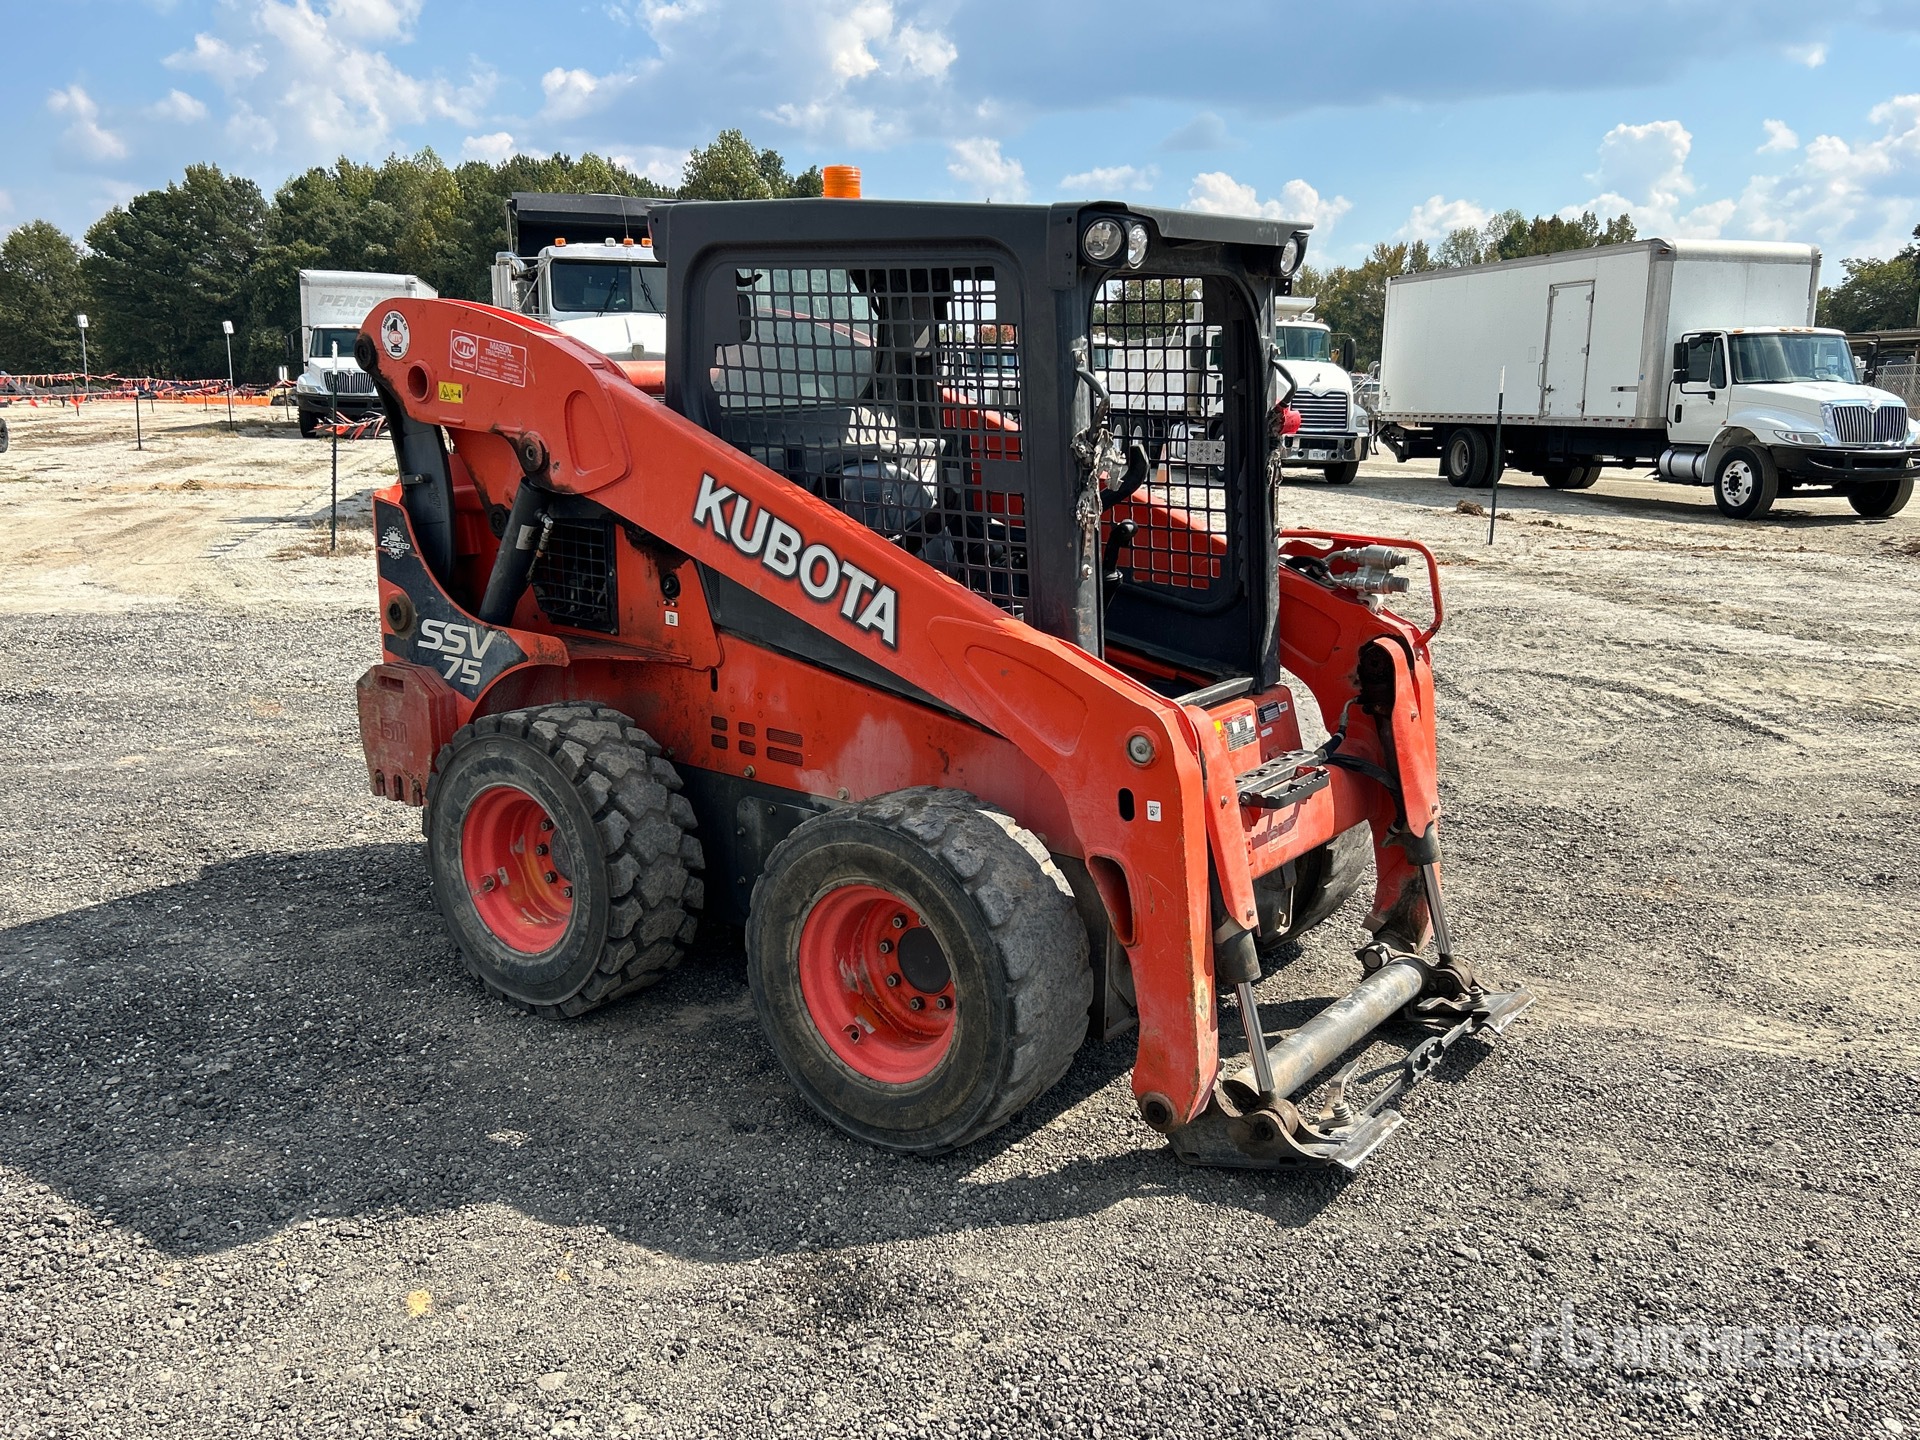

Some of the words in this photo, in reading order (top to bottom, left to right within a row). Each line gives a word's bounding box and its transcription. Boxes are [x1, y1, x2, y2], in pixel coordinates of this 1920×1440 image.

[489, 342, 512, 354] MASON
[692, 472, 897, 648] KUBOTA
[417, 618, 496, 660] SSV
[443, 656, 482, 686] 75
